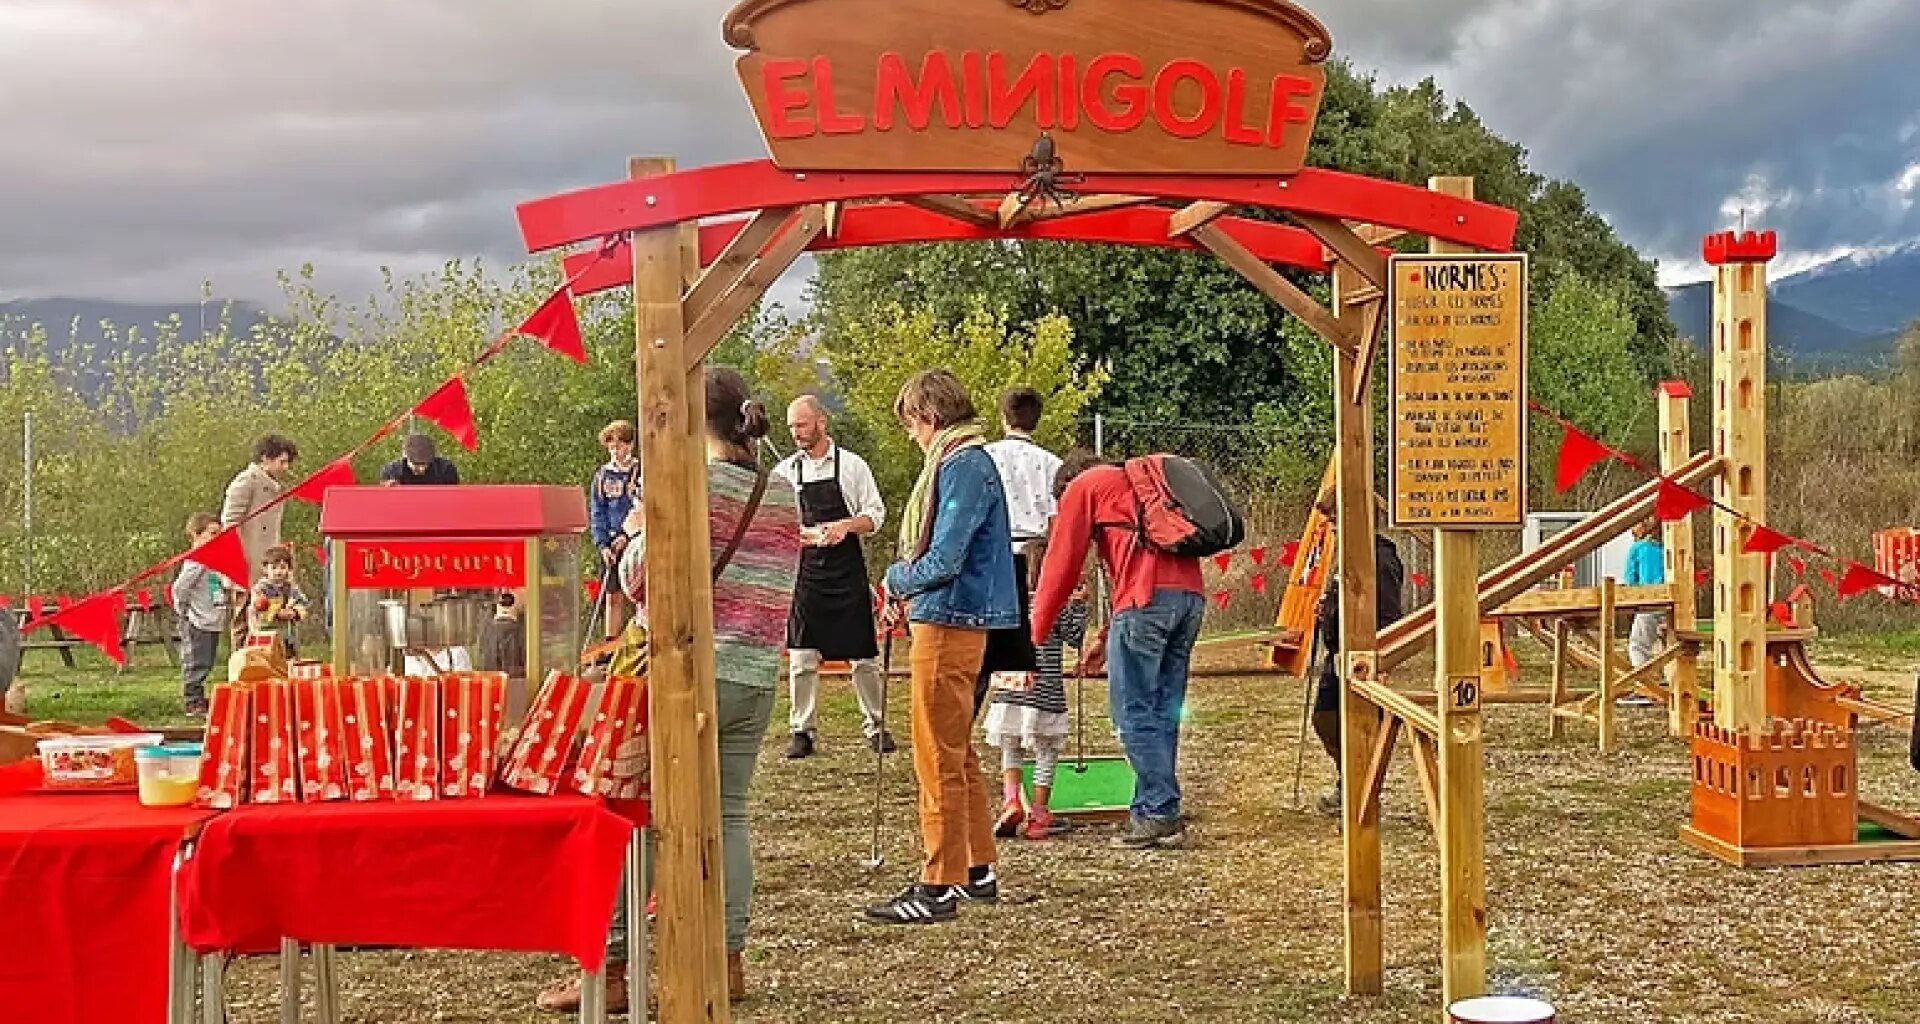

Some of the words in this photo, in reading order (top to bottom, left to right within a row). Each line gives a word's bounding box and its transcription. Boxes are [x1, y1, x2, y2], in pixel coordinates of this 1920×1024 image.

[761, 55, 865, 137] EL
[358, 547, 515, 580] Popcorn
[1453, 681, 1475, 706] 10
